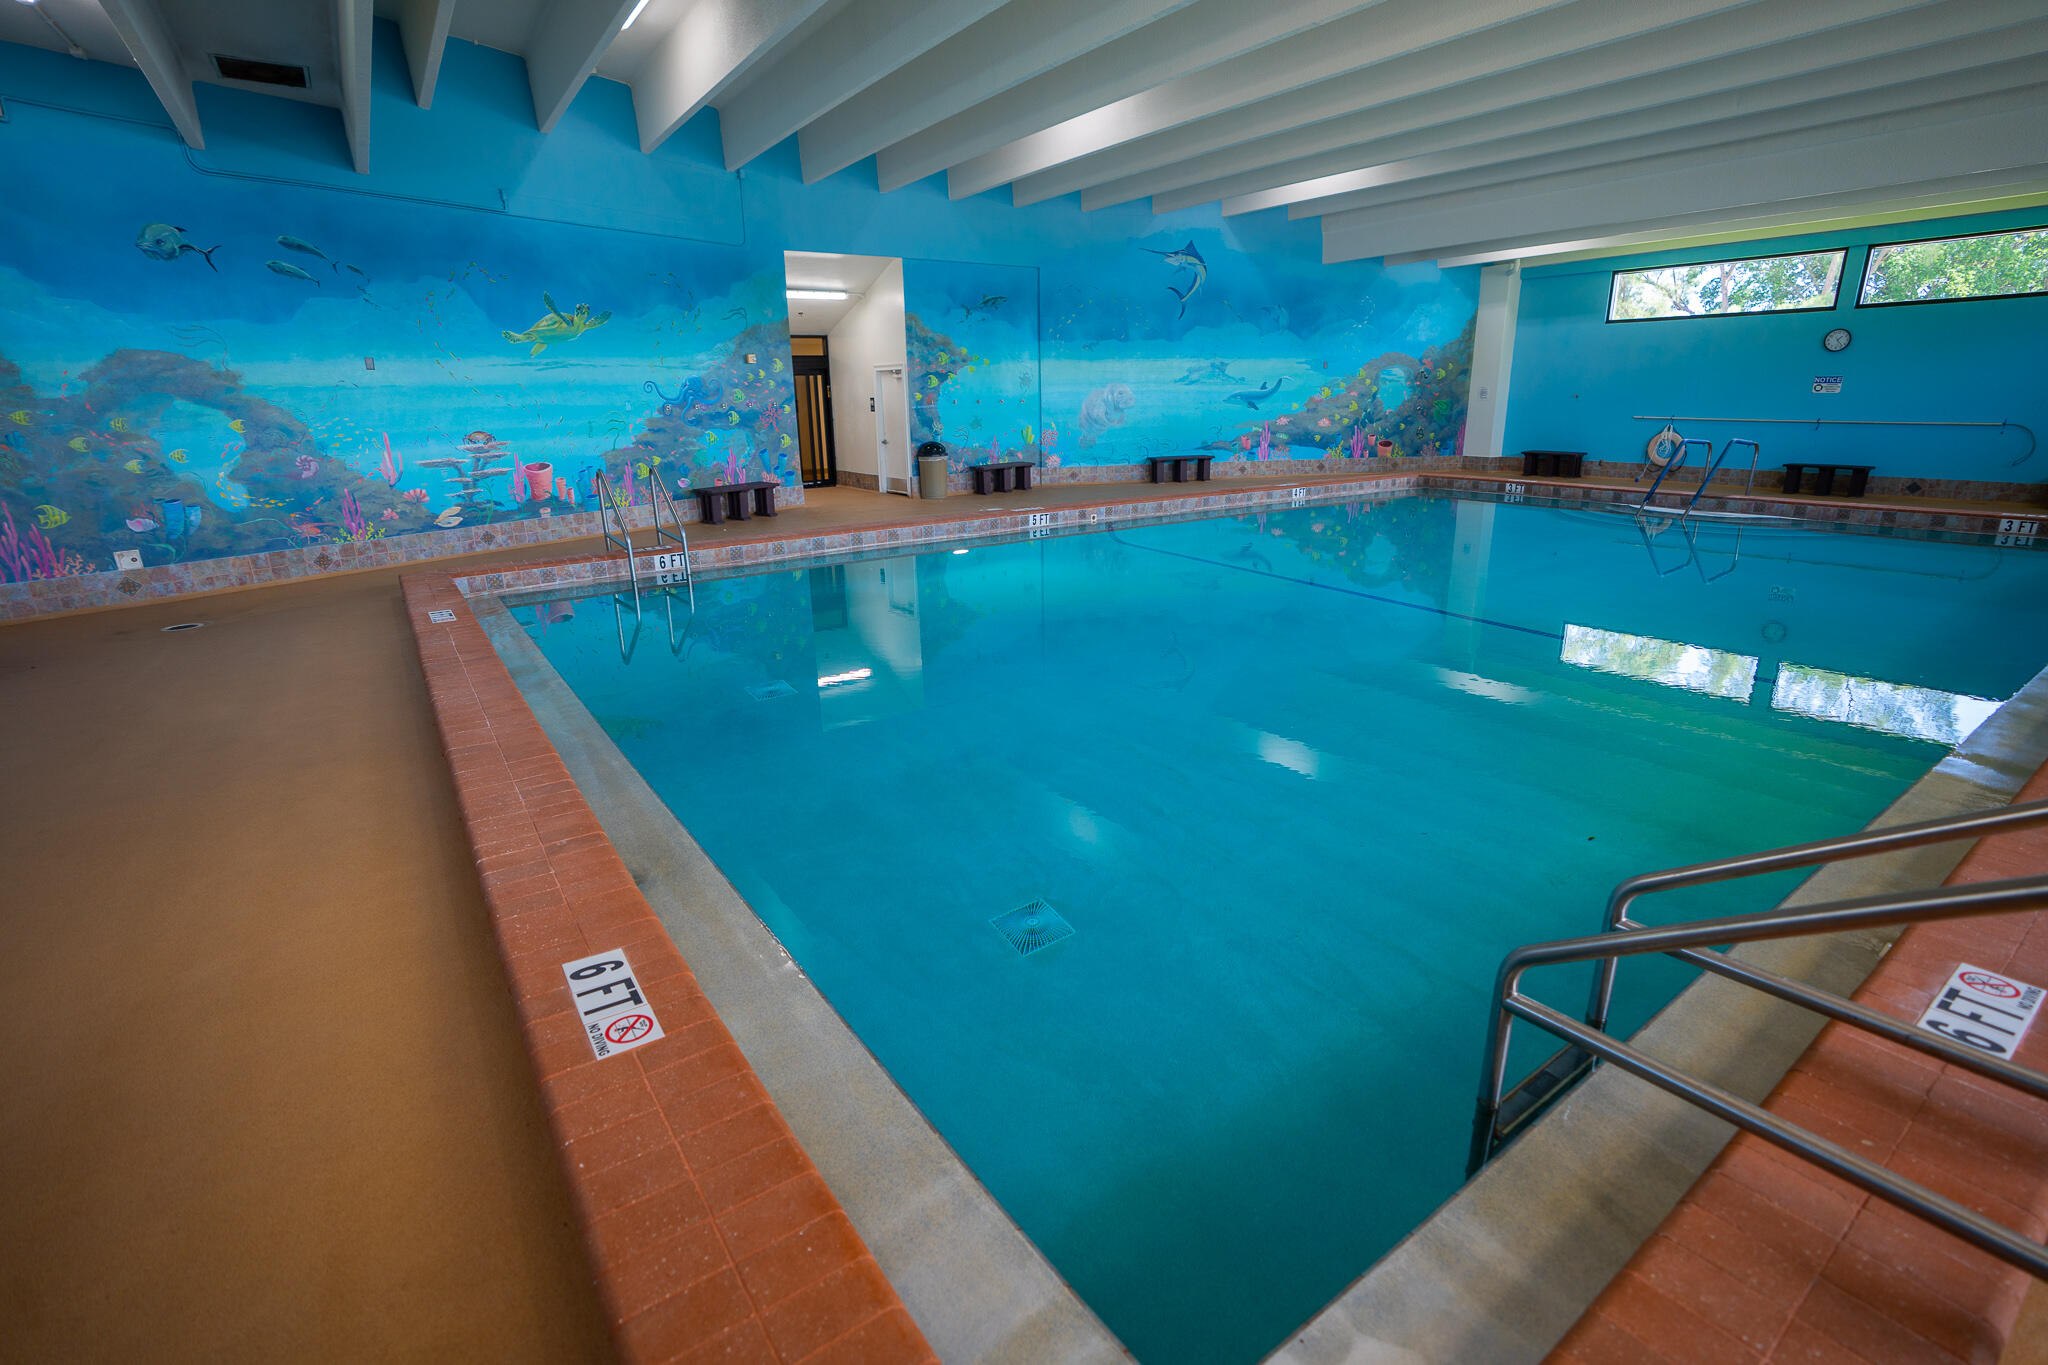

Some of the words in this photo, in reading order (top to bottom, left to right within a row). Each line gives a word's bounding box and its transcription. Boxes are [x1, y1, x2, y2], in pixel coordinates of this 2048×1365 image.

[1299, 487, 1306, 497] FT
[1514, 484, 1524, 493] FT
[1032, 514, 1037, 526] 5
[1040, 513, 1049, 526] FT
[2004, 520, 2014, 532] 3
[2018, 521, 2037, 533] FT
[659, 555, 666, 569] 6
[670, 553, 685, 568] FT
[569, 960, 624, 980] 6
[576, 977, 643, 1016] FT
[1937, 986, 2024, 1036] FT
[588, 1022, 601, 1034] NO
[1926, 1019, 2007, 1053] 6
[591, 1032, 611, 1057] DIVING
